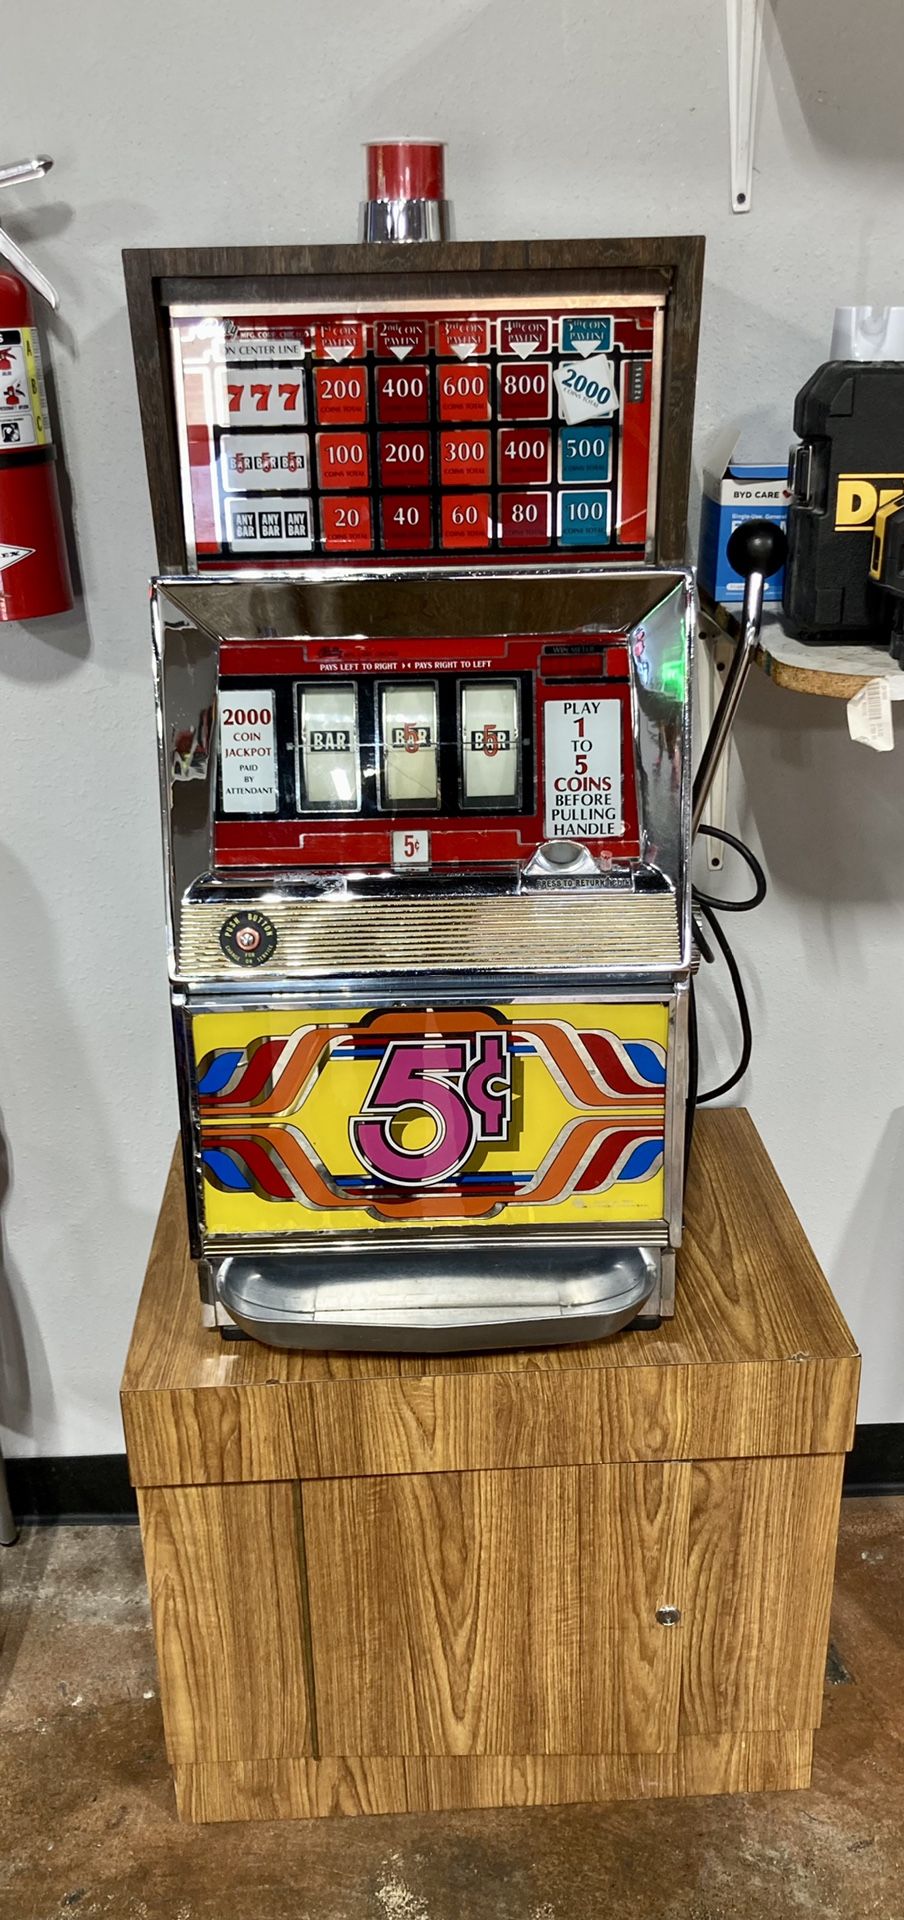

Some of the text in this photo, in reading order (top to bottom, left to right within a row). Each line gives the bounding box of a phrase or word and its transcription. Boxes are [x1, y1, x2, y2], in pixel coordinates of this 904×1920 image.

[398, 326, 423, 335] COIN
[459, 323, 484, 333] COIN
[522, 321, 546, 331] COIN
[583, 320, 607, 330] COIN
[239, 345, 275, 355] CENTER
[279, 344, 299, 353] LINE
[320, 379, 362, 400] 200
[382, 377, 424, 398] 400
[443, 376, 484, 397] 600
[504, 375, 546, 395] 800
[561, 369, 611, 405] 2000
[327, 444, 363, 464] 100
[385, 443, 425, 463] 200
[444, 442, 485, 462] 300
[504, 440, 545, 460] 400
[566, 438, 605, 458] 500
[236, 513, 305, 525] ANY ANY ANY
[334, 508, 360, 528] 20
[393, 507, 420, 526] 40
[451, 505, 478, 525] 60
[511, 504, 538, 523] 80
[568, 502, 603, 521] 100
[236, 525, 306, 537] BAR BAR BAR
[319, 660, 492, 672] PAYS LEFT TO RIGHT PAYS RIGHT TO LEFT
[563, 701, 601, 715] PLAY
[222, 708, 272, 726] 2000
[573, 717, 584, 737] 1
[233, 732, 261, 741] COIN
[314, 732, 347, 751] BAR
[225, 747, 272, 759] JACKPOT
[571, 739, 593, 753] TO
[239, 764, 258, 772] PAID
[574, 754, 588, 775] 5
[244, 776, 254, 784] BY
[554, 776, 612, 792] COINS
[226, 786, 273, 796] ATTENDANT
[555, 793, 612, 806] BEFORE
[552, 807, 616, 821] PULLING
[554, 822, 615, 836] HANDLE
[536, 878, 562, 889] PRESS
[563, 879, 573, 887] TO
[575, 879, 604, 887] RETURN
[224, 913, 273, 938] PUSH BUTTON
